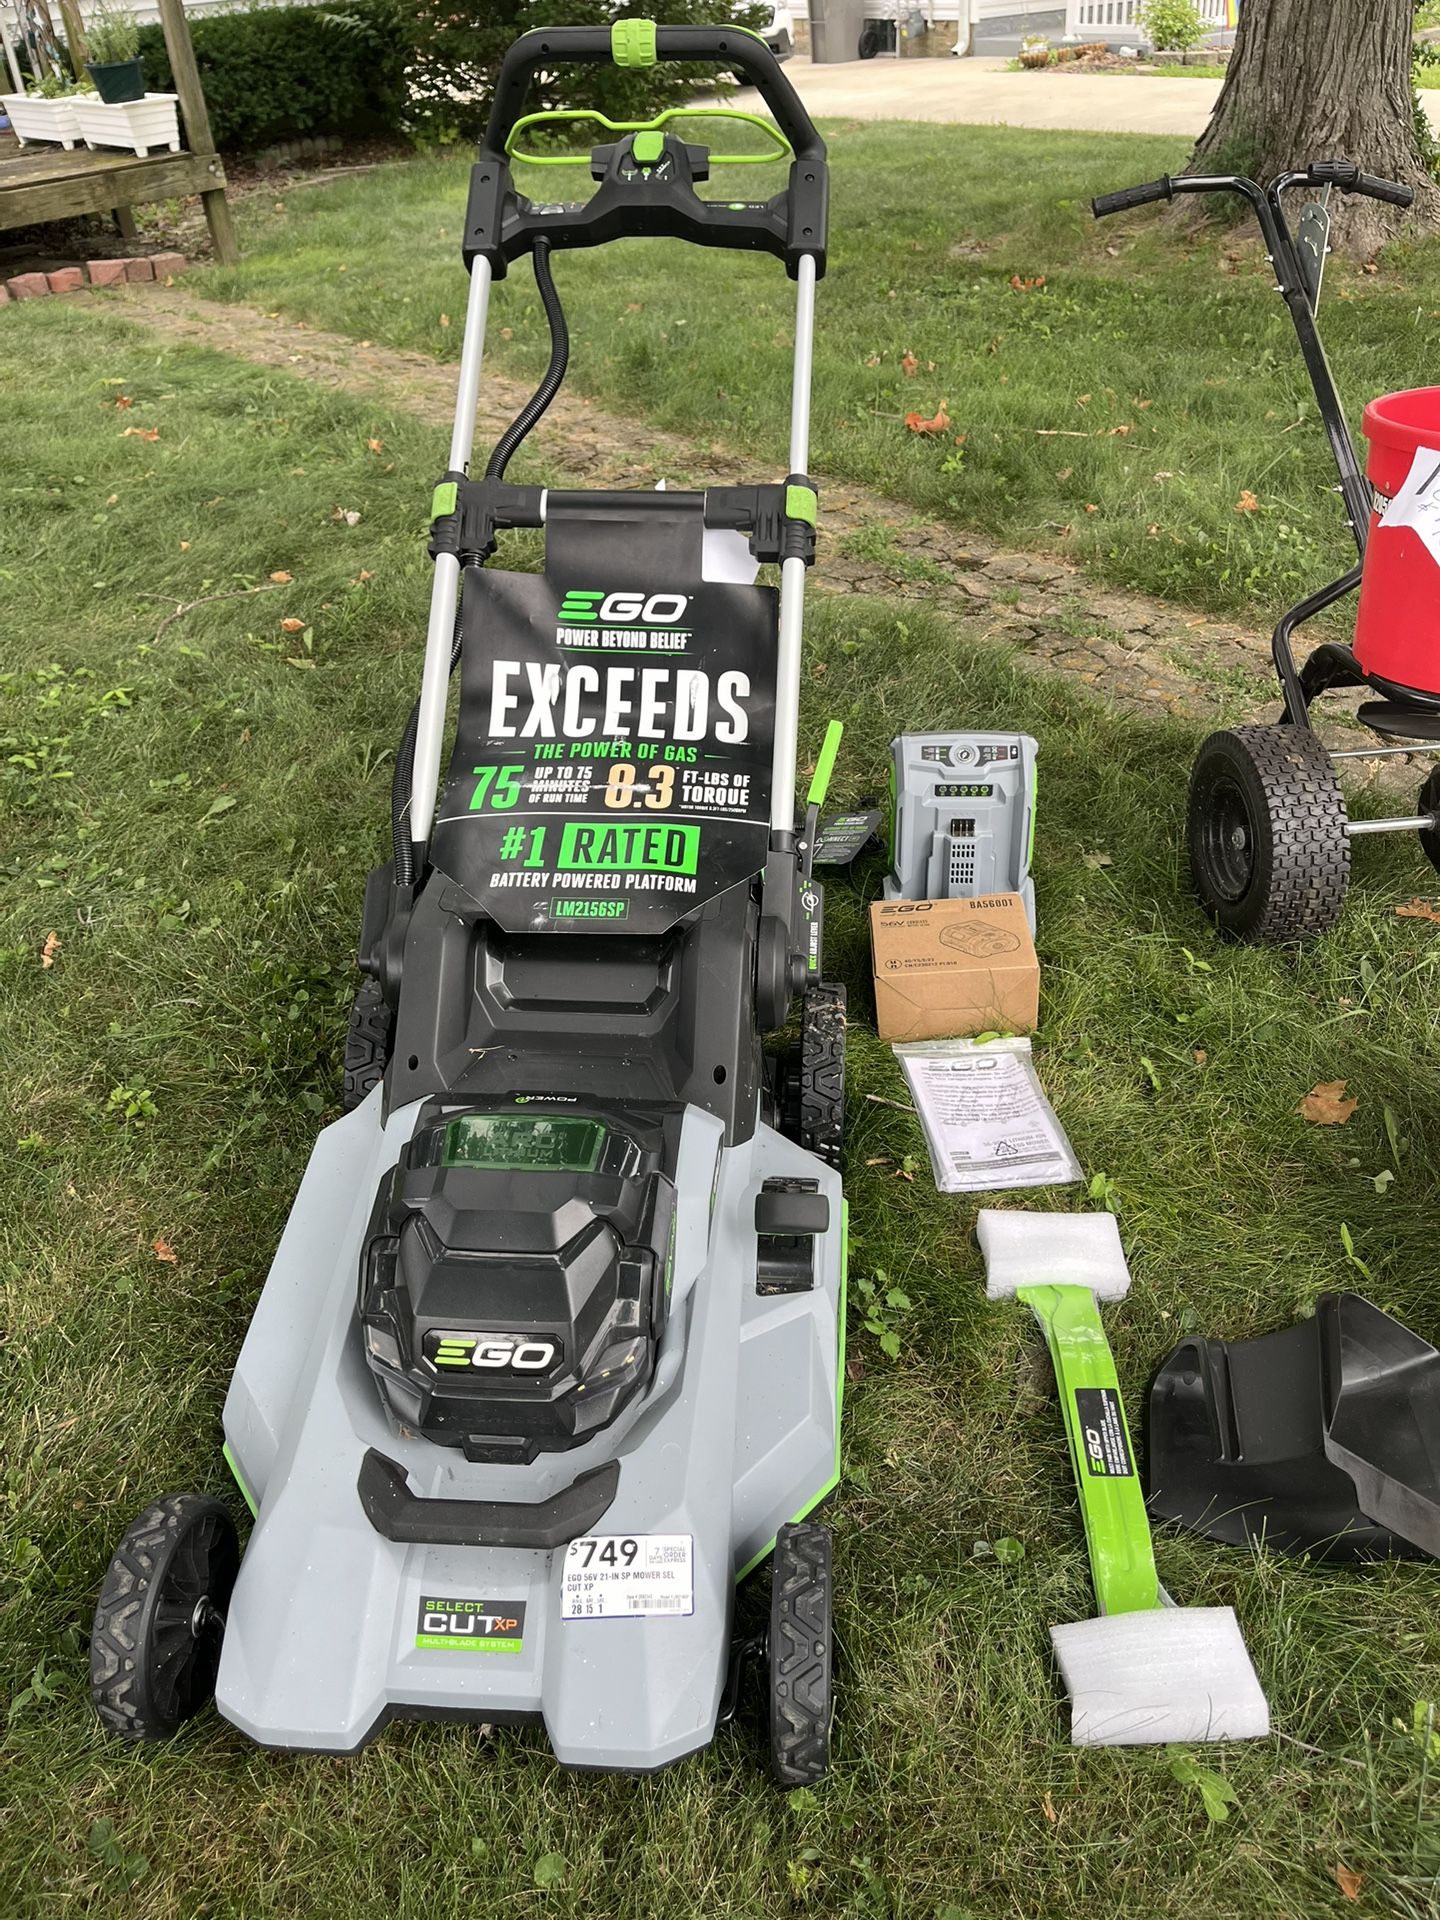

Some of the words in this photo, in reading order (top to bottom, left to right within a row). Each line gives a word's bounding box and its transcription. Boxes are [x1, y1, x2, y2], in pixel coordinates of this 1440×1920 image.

[557, 590, 688, 623] EGO
[556, 627, 599, 647] POWER
[602, 629, 647, 649] BEYOND
[650, 631, 689, 650] BELIEF
[488, 660, 750, 744] EXCEEDS
[534, 742, 565, 759] THE
[570, 742, 631, 758] POWER
[638, 743, 659, 760] OF
[664, 745, 698, 762] GAS
[534, 766, 553, 780] UP
[557, 766, 573, 780] TO
[577, 766, 593, 779] 75
[682, 770, 729, 786] FT-LBS
[733, 774, 751, 788] OF
[469, 765, 525, 810] 75
[530, 780, 591, 792] MINUTES
[604, 763, 676, 810] 8.3
[682, 785, 750, 806] TORQUE
[528, 794, 542, 804] OF
[542, 794, 562, 804] RUN
[564, 793, 588, 803] TIME
[500, 826, 547, 868] #1
[572, 828, 686, 867] RATED
[490, 872, 550, 888] BATTERY
[552, 873, 620, 890] POWERED
[624, 874, 697, 894] PLATFORM
[556, 900, 625, 918] LM2156SP
[880, 903, 934, 914] EGO
[434, 1338, 556, 1369] EGO
[1086, 1428, 1106, 1474] EGO
[570, 1539, 638, 1568] $749
[568, 1574, 582, 1582] EGO
[584, 1573, 598, 1581] 56V
[600, 1572, 619, 1581] 21-IN
[621, 1572, 631, 1580] SP
[633, 1571, 661, 1579] MOWER
[662, 1571, 675, 1579] SEL
[567, 1584, 581, 1592] CUT
[584, 1583, 594, 1591] XP
[426, 1600, 484, 1612] SELECT
[572, 1605, 582, 1615] 28
[423, 1612, 502, 1634] CUT
[422, 1638, 477, 1647] MULTI-BLADE
